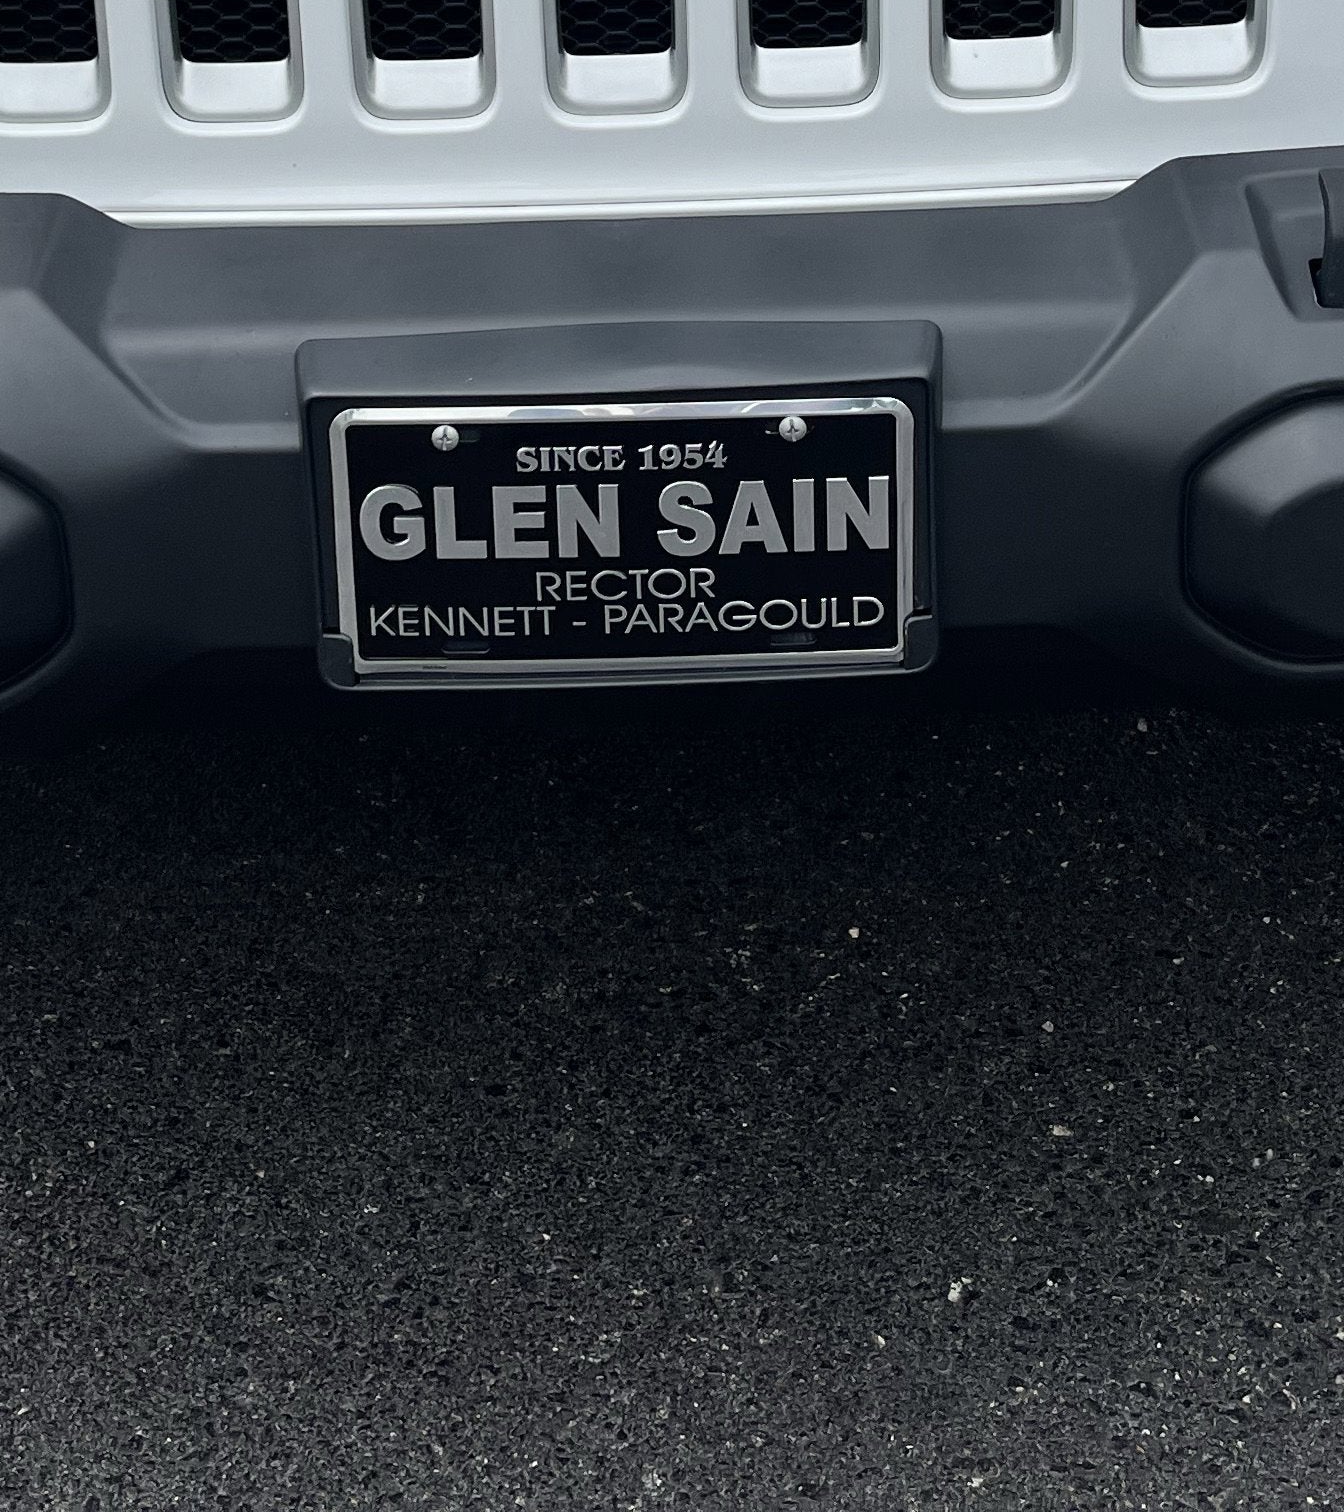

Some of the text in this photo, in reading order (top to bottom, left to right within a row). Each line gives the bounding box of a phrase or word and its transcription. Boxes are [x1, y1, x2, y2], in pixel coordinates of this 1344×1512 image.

[516, 440, 728, 474] SINCE 1954
[359, 475, 891, 561] GLEN SAIN
[535, 567, 717, 603] RECTOR
[370, 604, 556, 638] KENNETT
[603, 596, 885, 635] PARAGOULD
